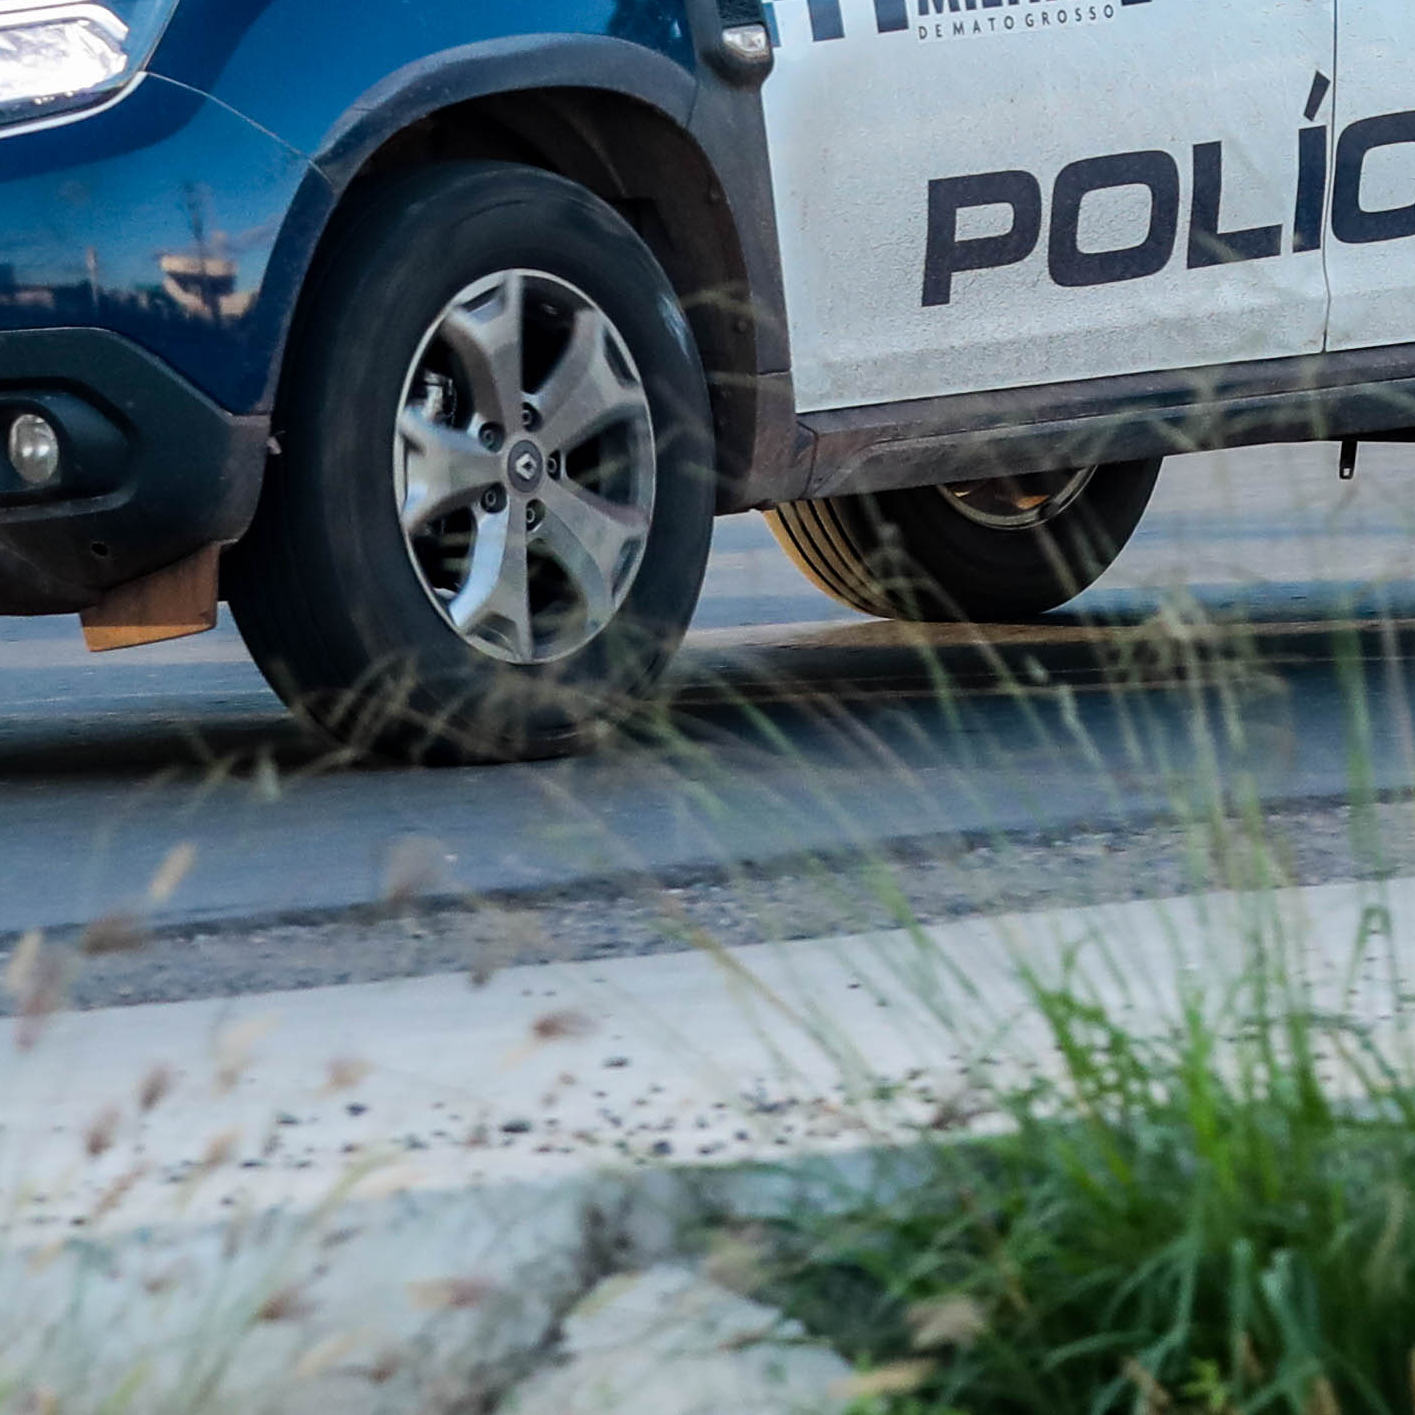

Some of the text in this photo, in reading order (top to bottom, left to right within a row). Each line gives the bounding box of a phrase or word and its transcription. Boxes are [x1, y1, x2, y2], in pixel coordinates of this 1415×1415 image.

[918, 3, 1115, 40] DE MATO GROSSO
